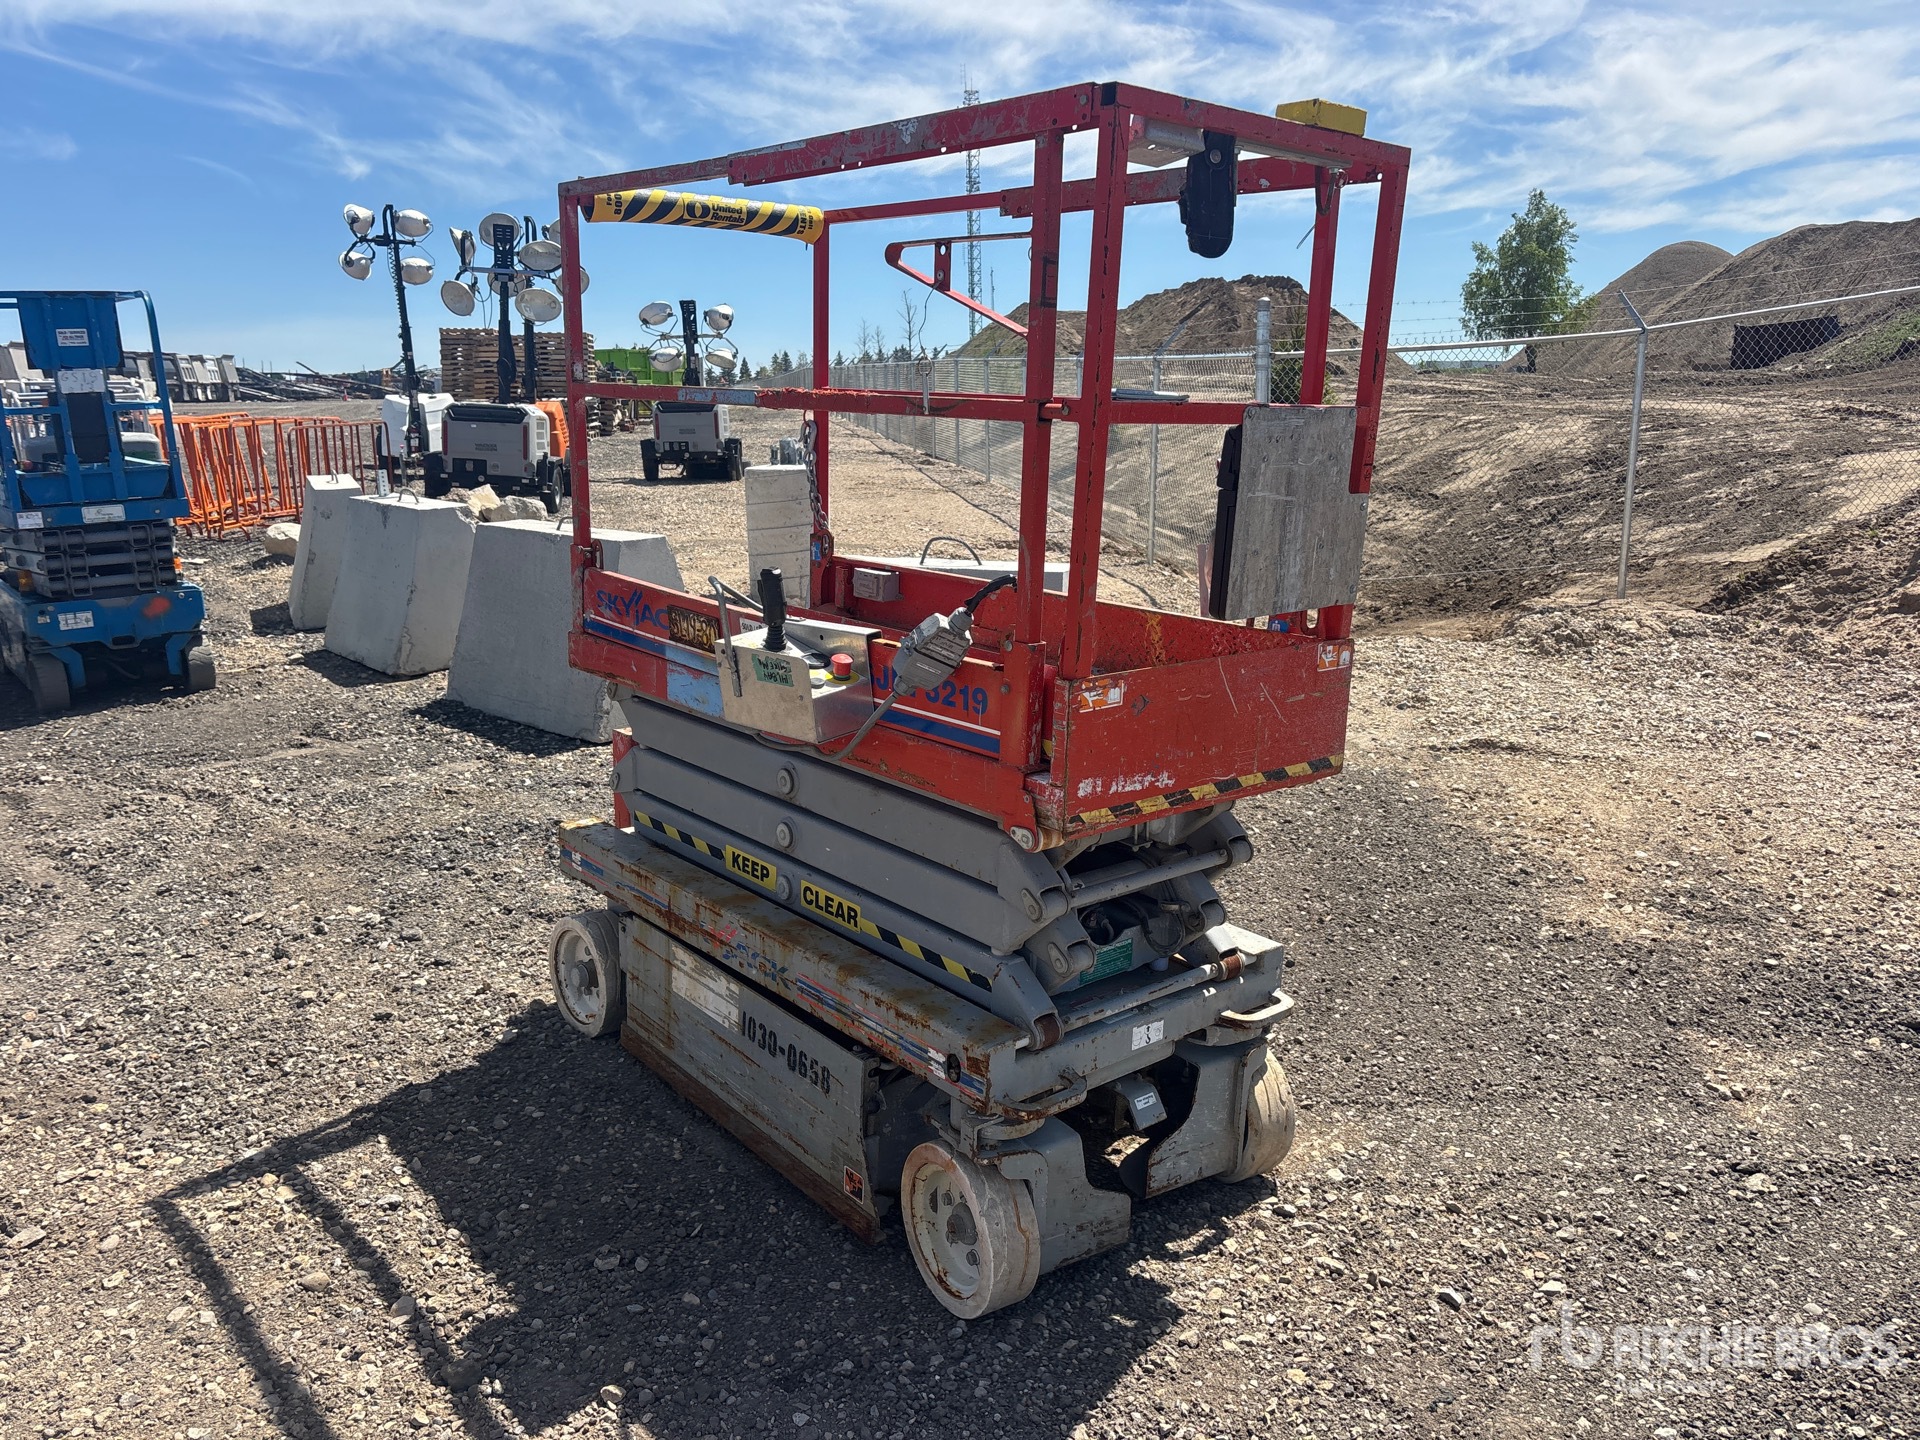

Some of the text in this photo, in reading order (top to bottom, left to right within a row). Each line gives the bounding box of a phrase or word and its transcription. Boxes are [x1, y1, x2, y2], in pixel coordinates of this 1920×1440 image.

[710, 212, 746, 224] Rentals
[711, 202, 743, 215] United
[595, 588, 670, 631] SKYJAC
[925, 680, 988, 716] 3219
[731, 850, 770, 883] KEEP
[802, 885, 859, 929] CLEAR
[742, 1010, 831, 1095] 1030-0658
